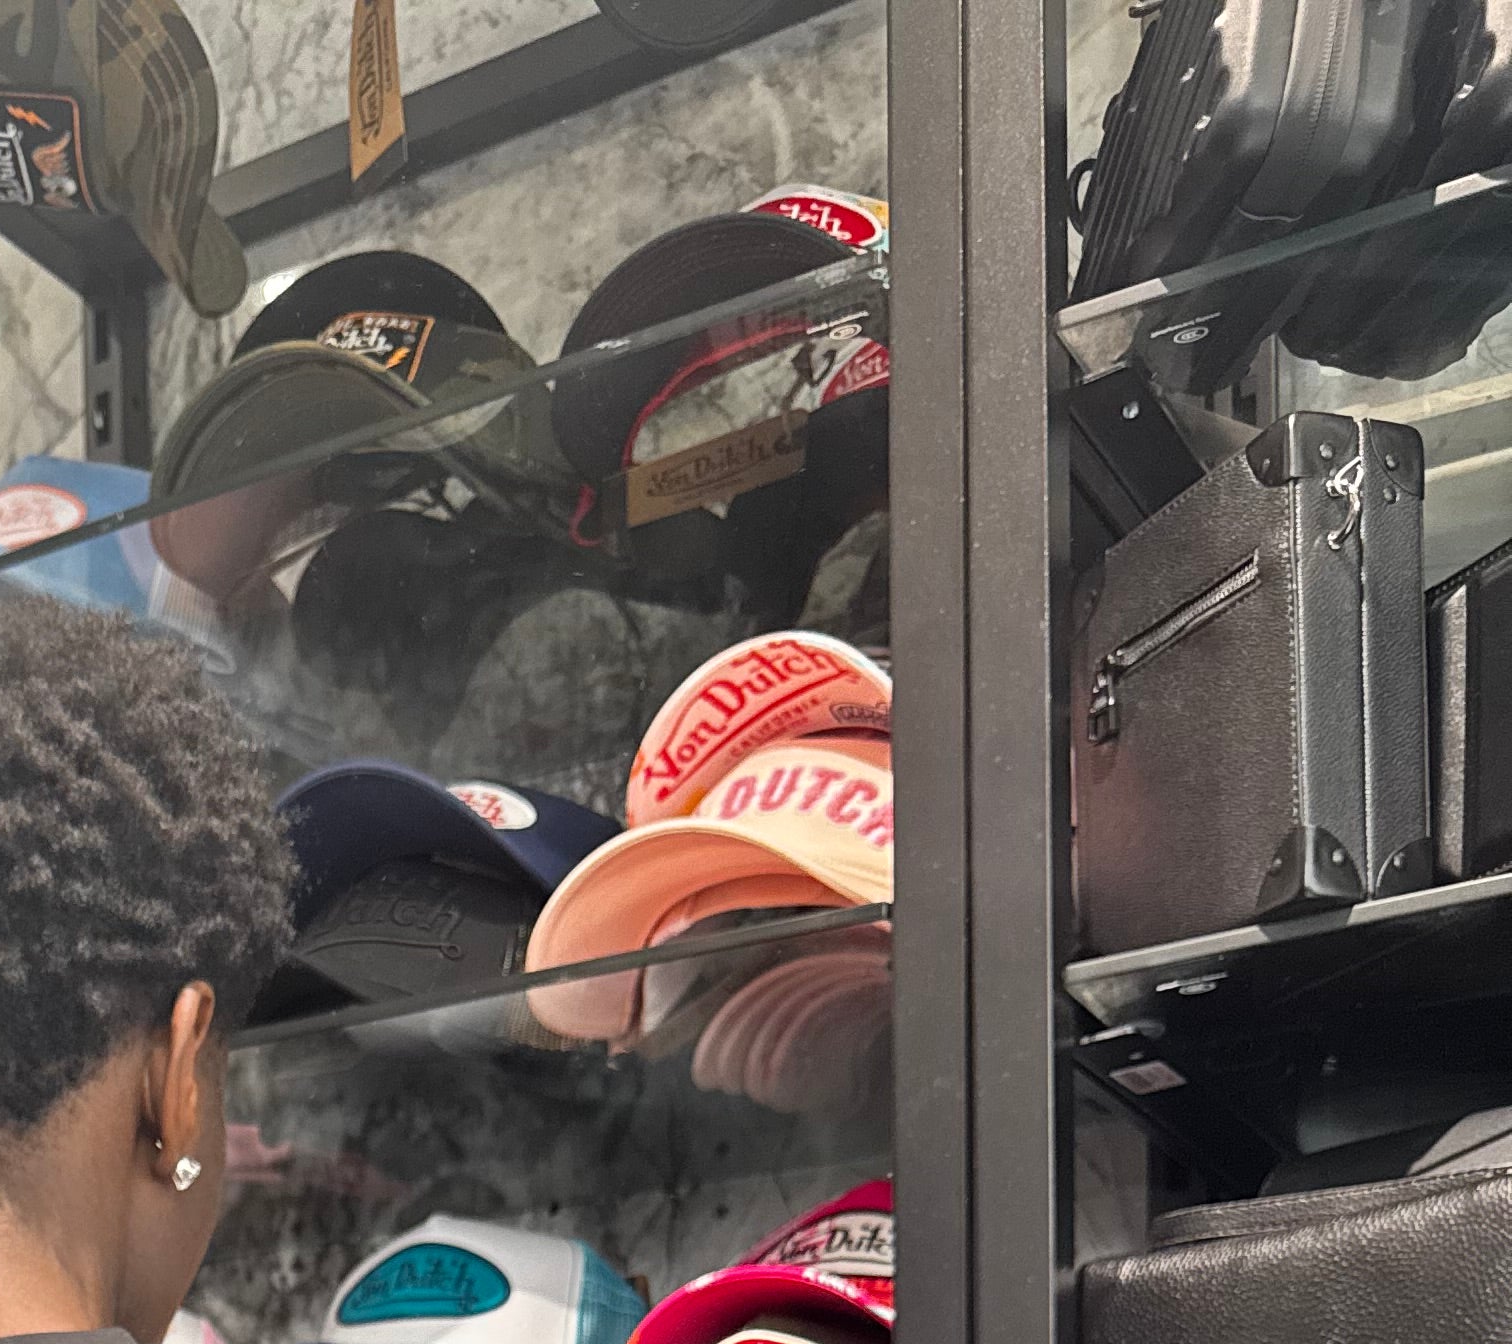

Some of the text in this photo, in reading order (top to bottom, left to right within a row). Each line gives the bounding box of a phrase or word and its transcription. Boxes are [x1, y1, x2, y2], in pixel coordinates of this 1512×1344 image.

[643, 639, 850, 791] Von Dutch
[393, 1255, 479, 1306] Dutch
